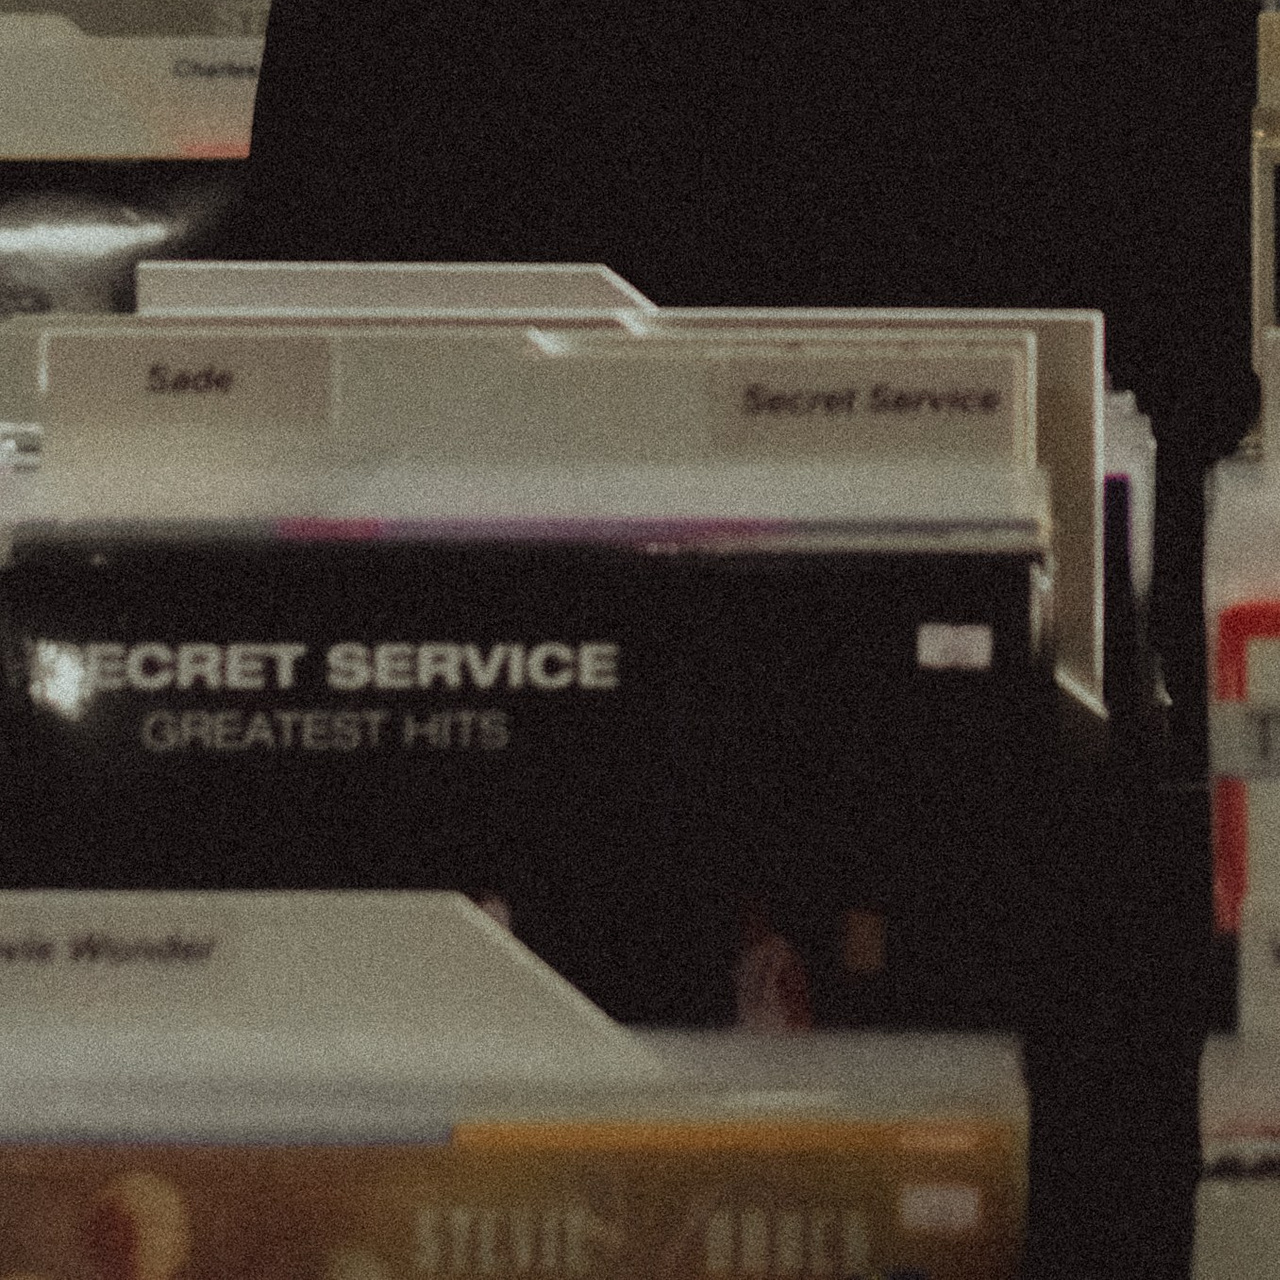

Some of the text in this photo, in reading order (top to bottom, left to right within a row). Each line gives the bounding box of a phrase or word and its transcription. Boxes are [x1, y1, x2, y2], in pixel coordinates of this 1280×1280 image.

[147, 363, 235, 394] Sade
[742, 383, 1001, 416] Secret Service
[326, 640, 621, 692] SERVICE
[141, 709, 510, 752] GREATEST HITS
[68, 931, 215, 966] Wonder
